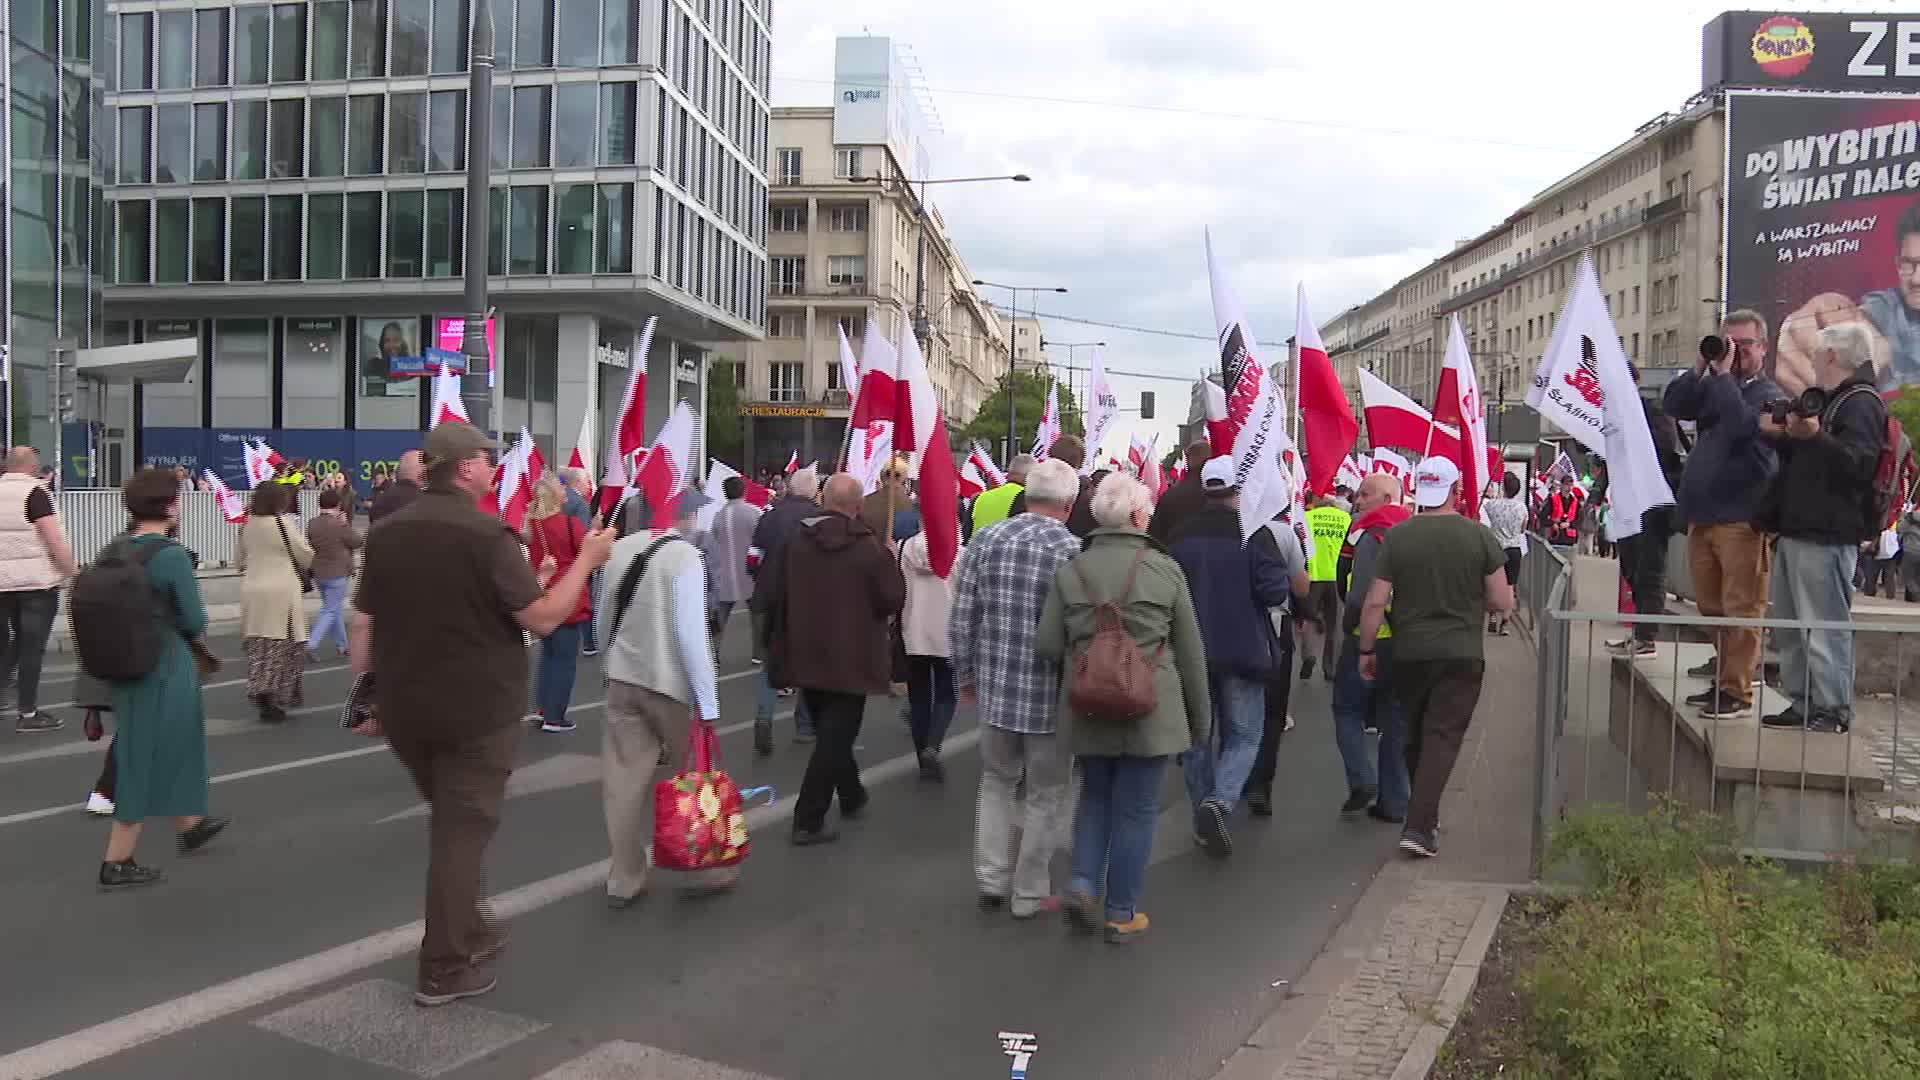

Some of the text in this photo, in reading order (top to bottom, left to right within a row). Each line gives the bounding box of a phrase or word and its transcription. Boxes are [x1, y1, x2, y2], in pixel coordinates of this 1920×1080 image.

[1745, 121, 1920, 178] DO WYBITN
[1763, 172, 1847, 209] ŚWIAT
[1755, 215, 1877, 245] A WARSZAWIACY
[1777, 239, 1860, 262] SĄ WYBITNI
